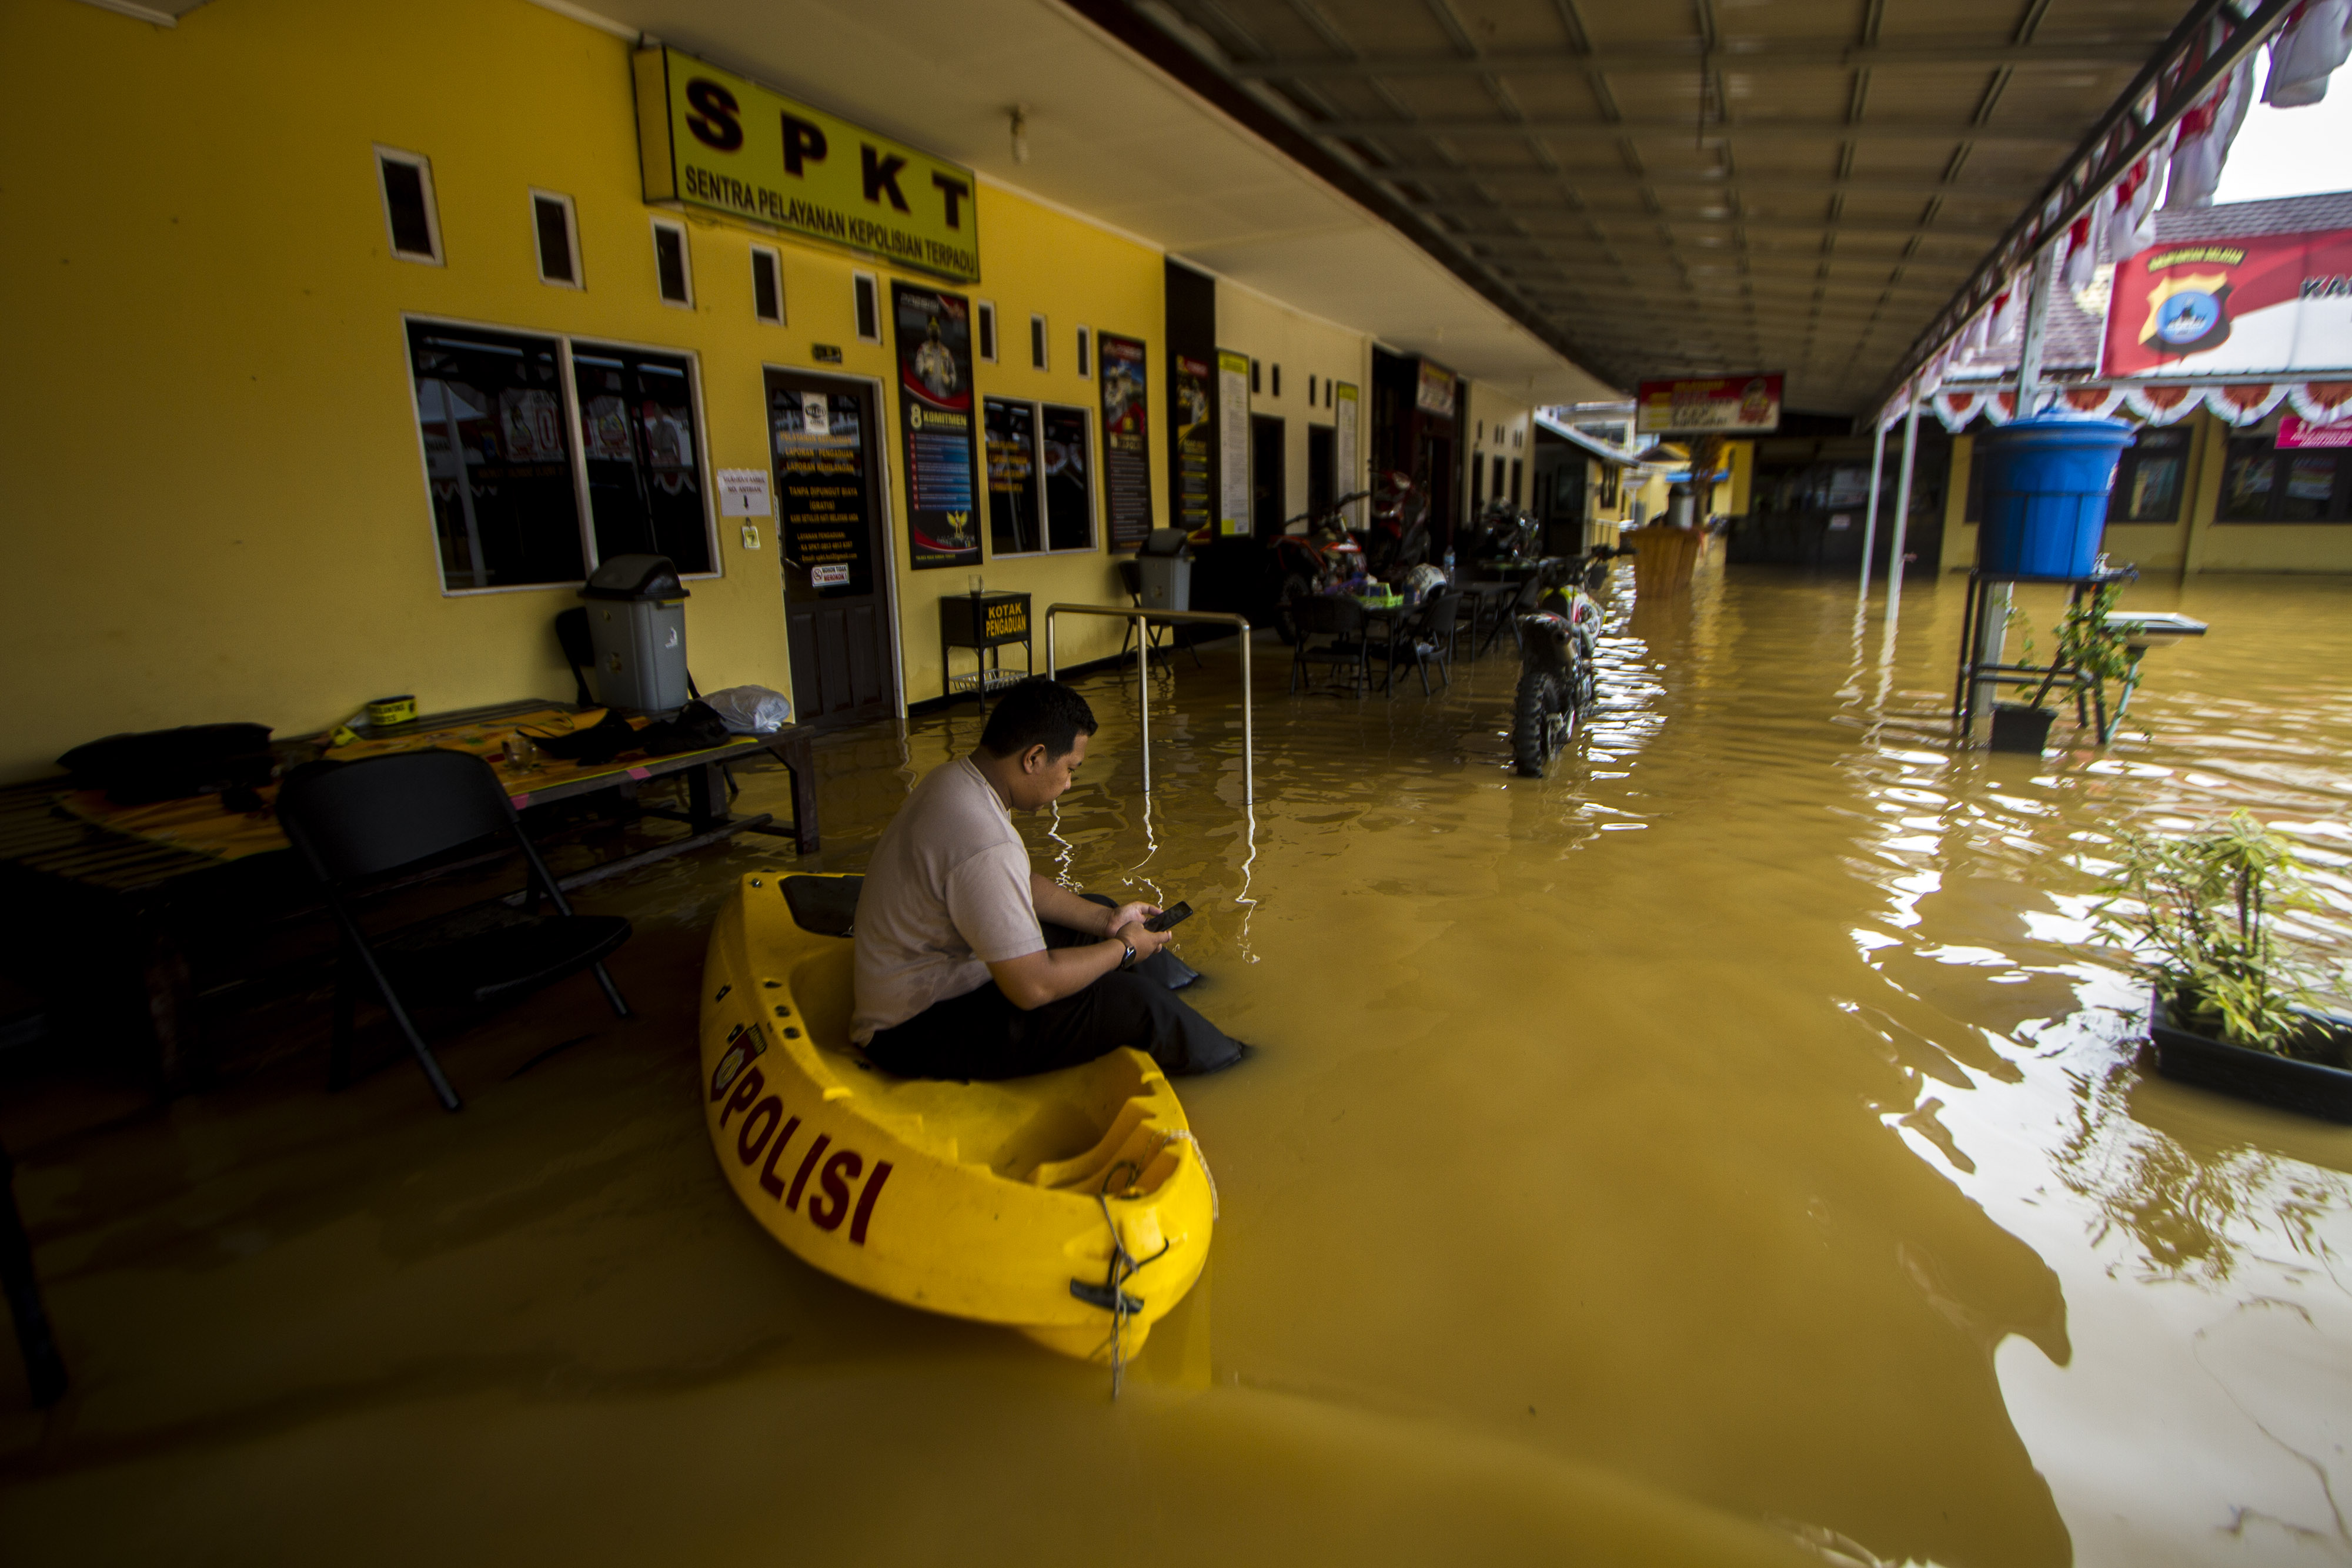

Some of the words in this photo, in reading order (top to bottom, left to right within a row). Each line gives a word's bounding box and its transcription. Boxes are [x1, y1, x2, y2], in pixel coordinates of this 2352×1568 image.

[686, 165, 756, 213] SENTRA
[758, 186, 846, 238] PELAYANAN
[848, 214, 923, 259] KEPOLISIAN
[924, 238, 975, 273] TERPADU
[2298, 273, 2352, 300] KA
[910, 403, 922, 430] 8
[923, 410, 967, 426] KOMITMEN
[785, 447, 814, 457] LAPORAN
[818, 449, 854, 459] PENGADUAN
[786, 461, 815, 472] LAPORAN
[816, 462, 854, 473] KEHILANGAN
[789, 486, 810, 497] TANPA
[810, 486, 841, 497] DIPUNGUT
[841, 486, 858, 497] BIAYA
[809, 499, 836, 512] (GRATIS)
[797, 531, 818, 541] LAYANAN
[988, 601, 1022, 619] KOTAK
[985, 614, 1026, 638] PENGADUAN
[719, 1067, 893, 1246] POLISI
